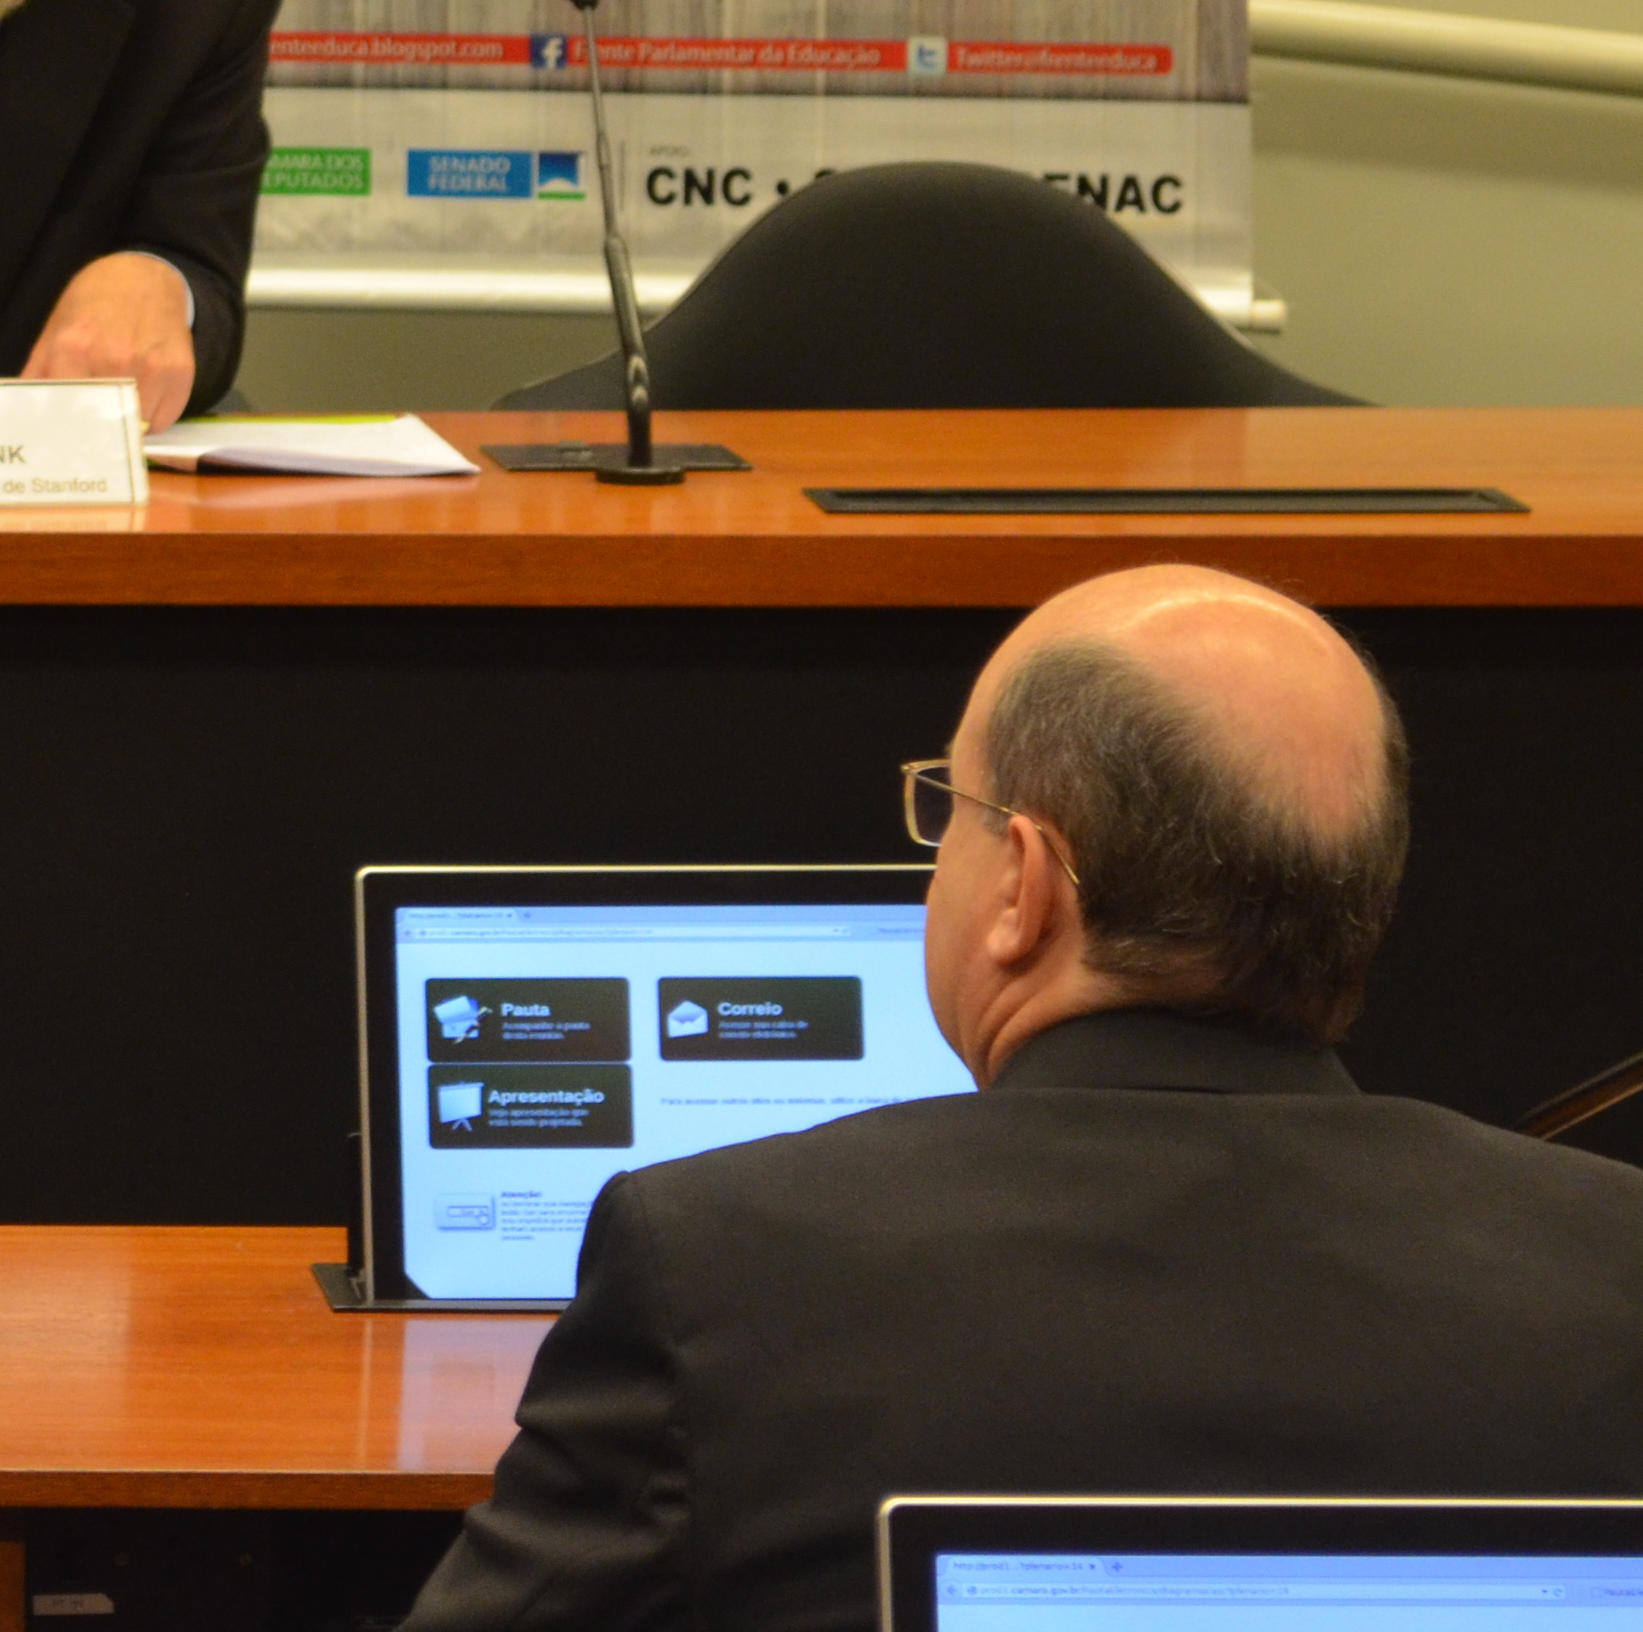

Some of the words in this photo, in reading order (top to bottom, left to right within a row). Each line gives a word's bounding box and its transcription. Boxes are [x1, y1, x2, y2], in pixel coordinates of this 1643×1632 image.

[574, 41, 635, 62] Fente
[638, 42, 755, 64] Parlamentar
[758, 43, 784, 64] da
[788, 43, 882, 67] Educação
[427, 155, 511, 173] SENADO
[262, 172, 364, 190] EPUTADOS
[427, 174, 508, 192] FEDERAL
[646, 168, 753, 207] CNC
[1043, 175, 1184, 215] NAC
[2, 478, 26, 494] de
[31, 477, 108, 494] Stanford
[500, 1003, 552, 1017] Pauta
[717, 1001, 784, 1016] Correio
[488, 1088, 605, 1106] Apresentação
